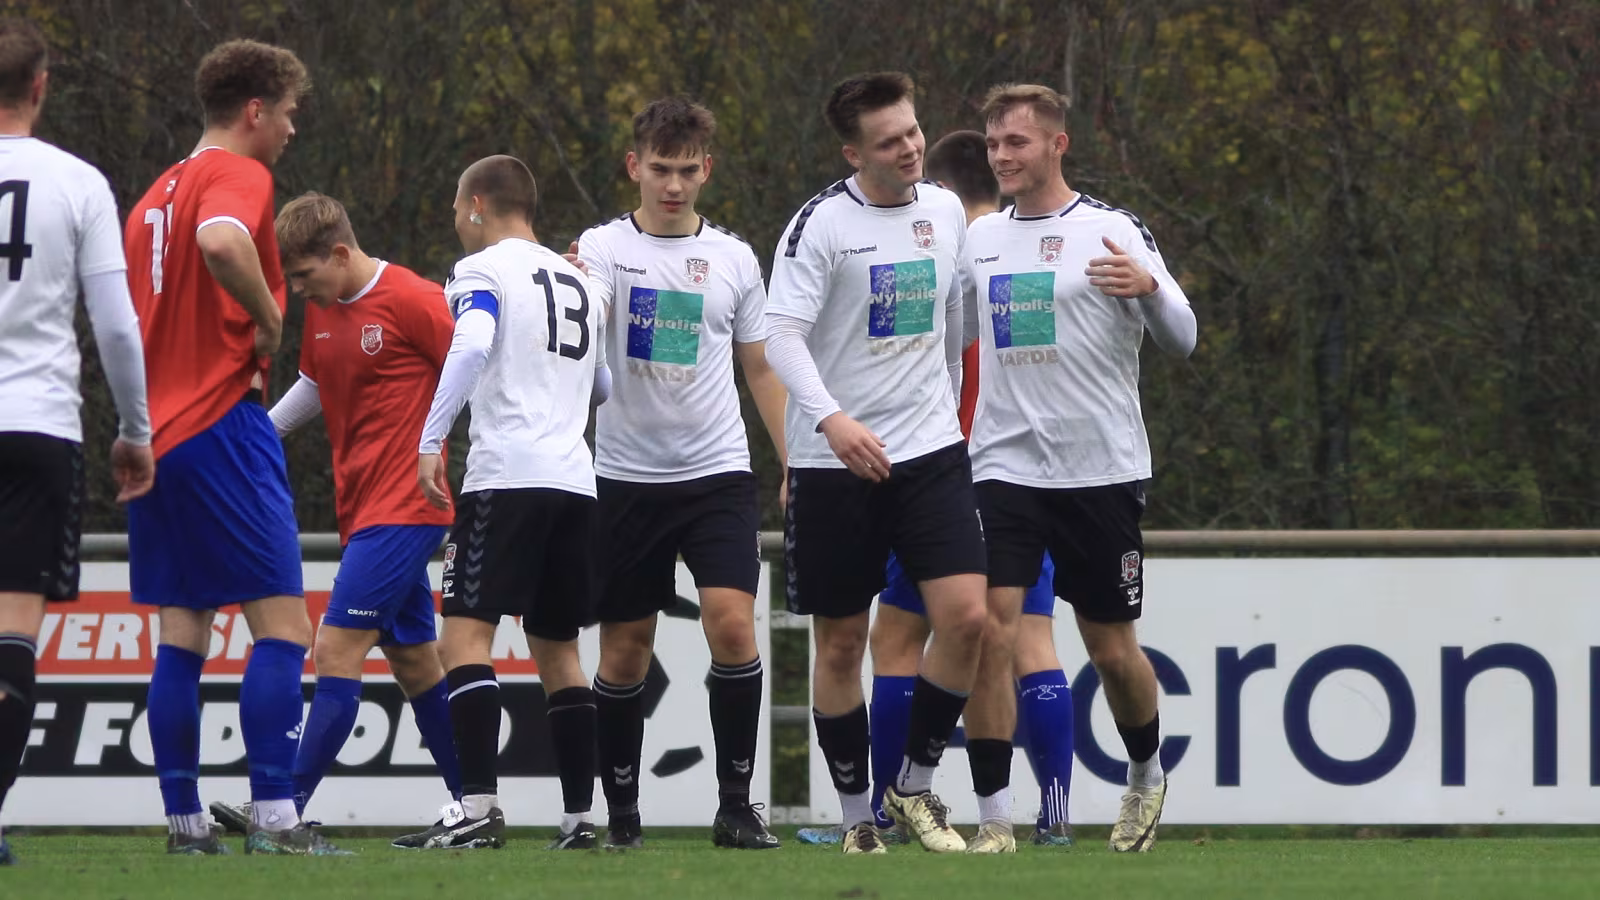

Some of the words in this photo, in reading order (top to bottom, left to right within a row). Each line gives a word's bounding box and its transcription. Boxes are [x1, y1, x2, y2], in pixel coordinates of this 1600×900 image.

[532, 267, 591, 361] 13
[347, 608, 374, 617] CRAFT
[945, 642, 1600, 787] cron
